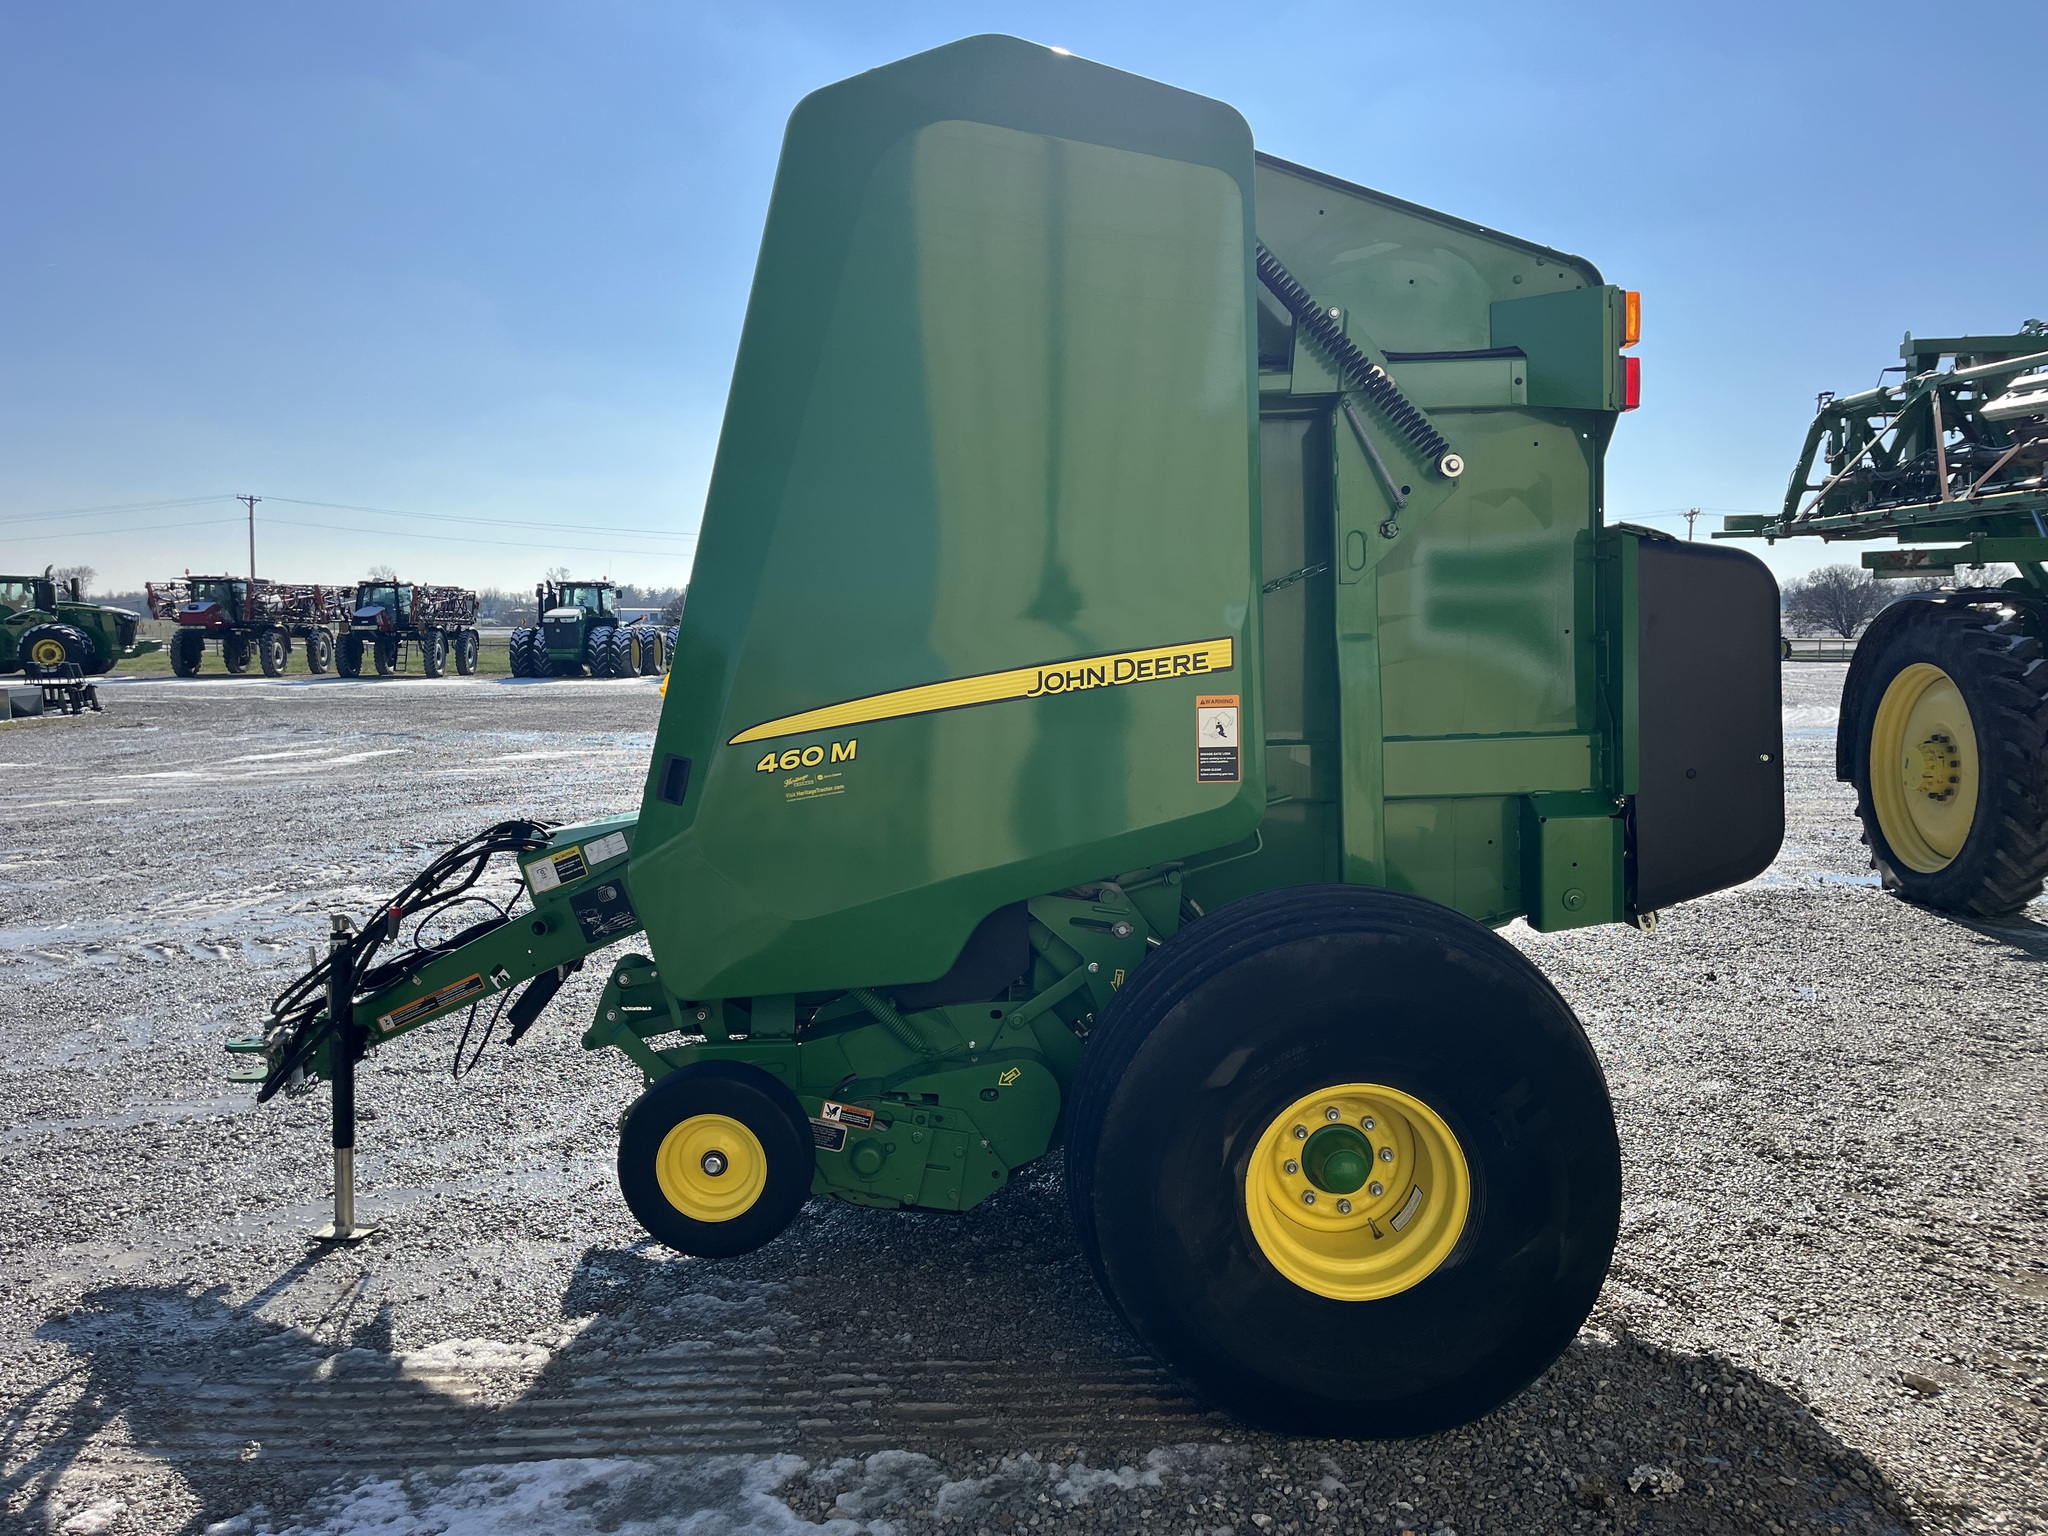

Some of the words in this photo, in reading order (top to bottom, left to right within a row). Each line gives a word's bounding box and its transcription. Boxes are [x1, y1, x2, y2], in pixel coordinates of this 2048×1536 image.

[1028, 666, 1105, 694] JOHN
[1114, 652, 1209, 682] DEERE
[757, 745, 825, 773] 460
[830, 739, 858, 763] M
[796, 785, 845, 796] HeritageTractor.com
[558, 850, 576, 858] CAUTION
